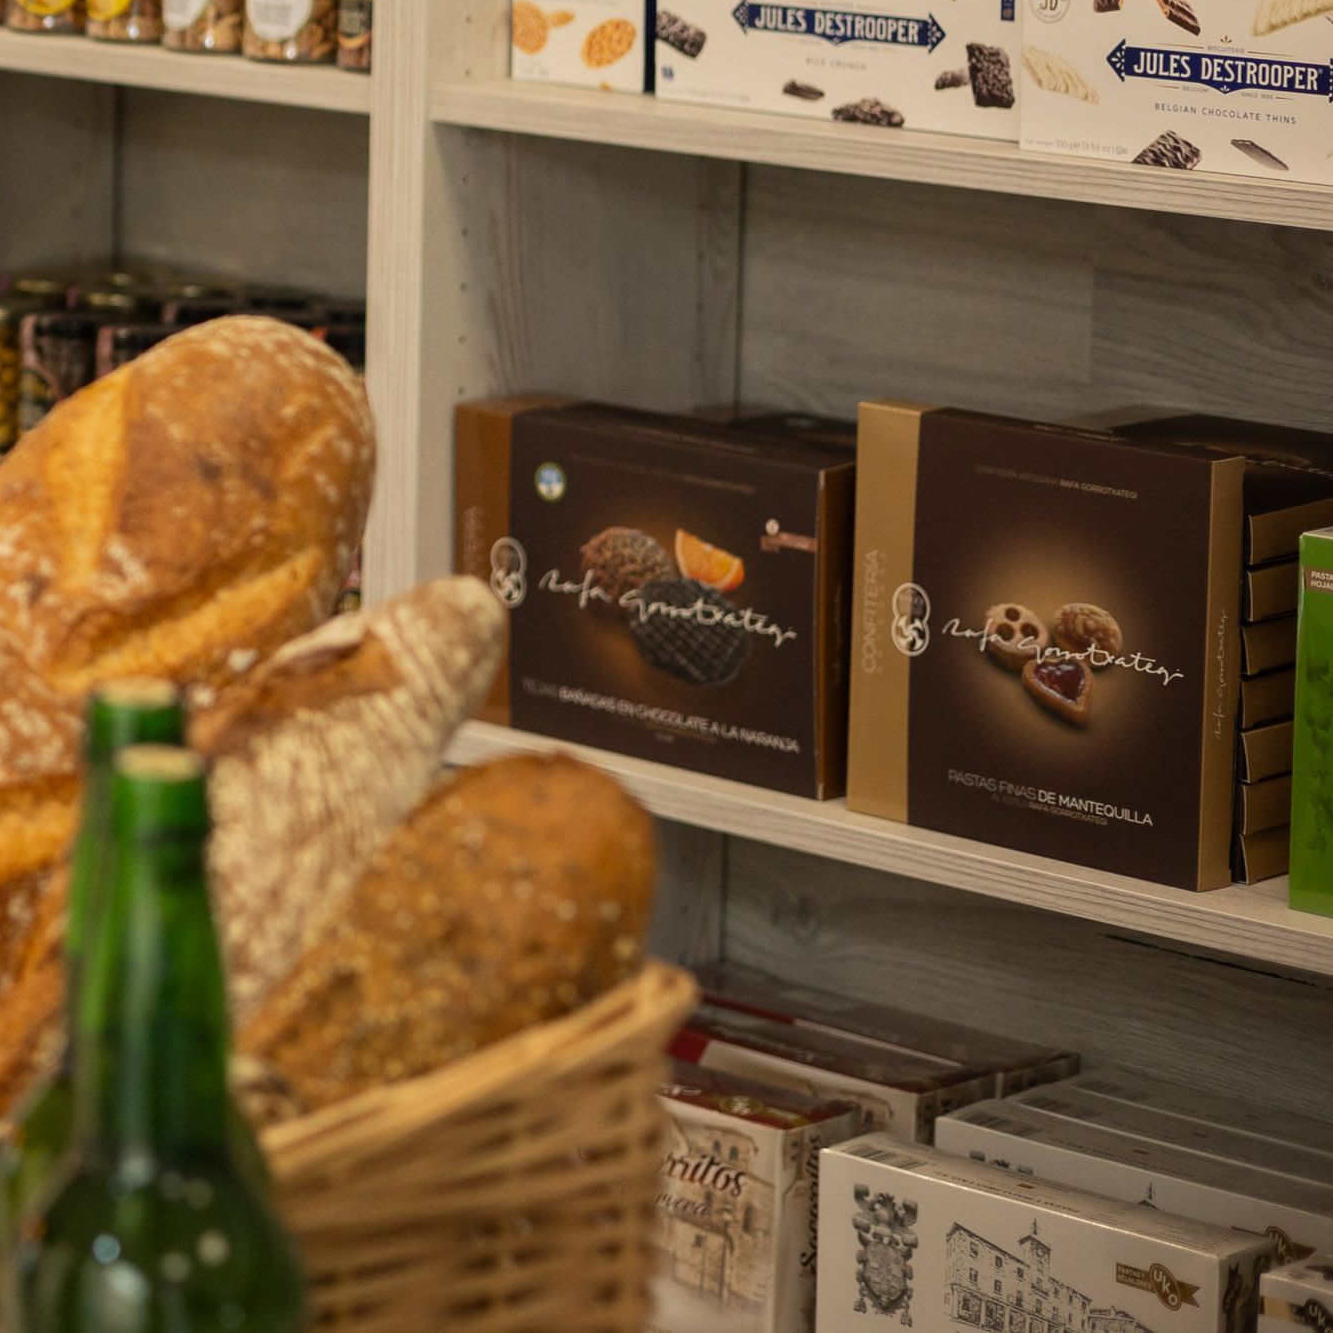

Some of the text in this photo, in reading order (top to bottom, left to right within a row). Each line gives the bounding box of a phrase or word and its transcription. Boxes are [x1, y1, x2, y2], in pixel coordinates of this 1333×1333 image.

[754, 6, 919, 44] JULES DESTROOPER
[1133, 51, 1319, 91] JULES DESTROOPER
[1154, 102, 1297, 125] BELGIAN CHOCOLATE THINS
[1310, 580, 1333, 590] HOJAL
[948, 768, 997, 792] PASTAS
[999, 780, 1037, 801] FINAS
[1038, 789, 1056, 805] DE
[1059, 794, 1153, 826] MANTEQUILLA
